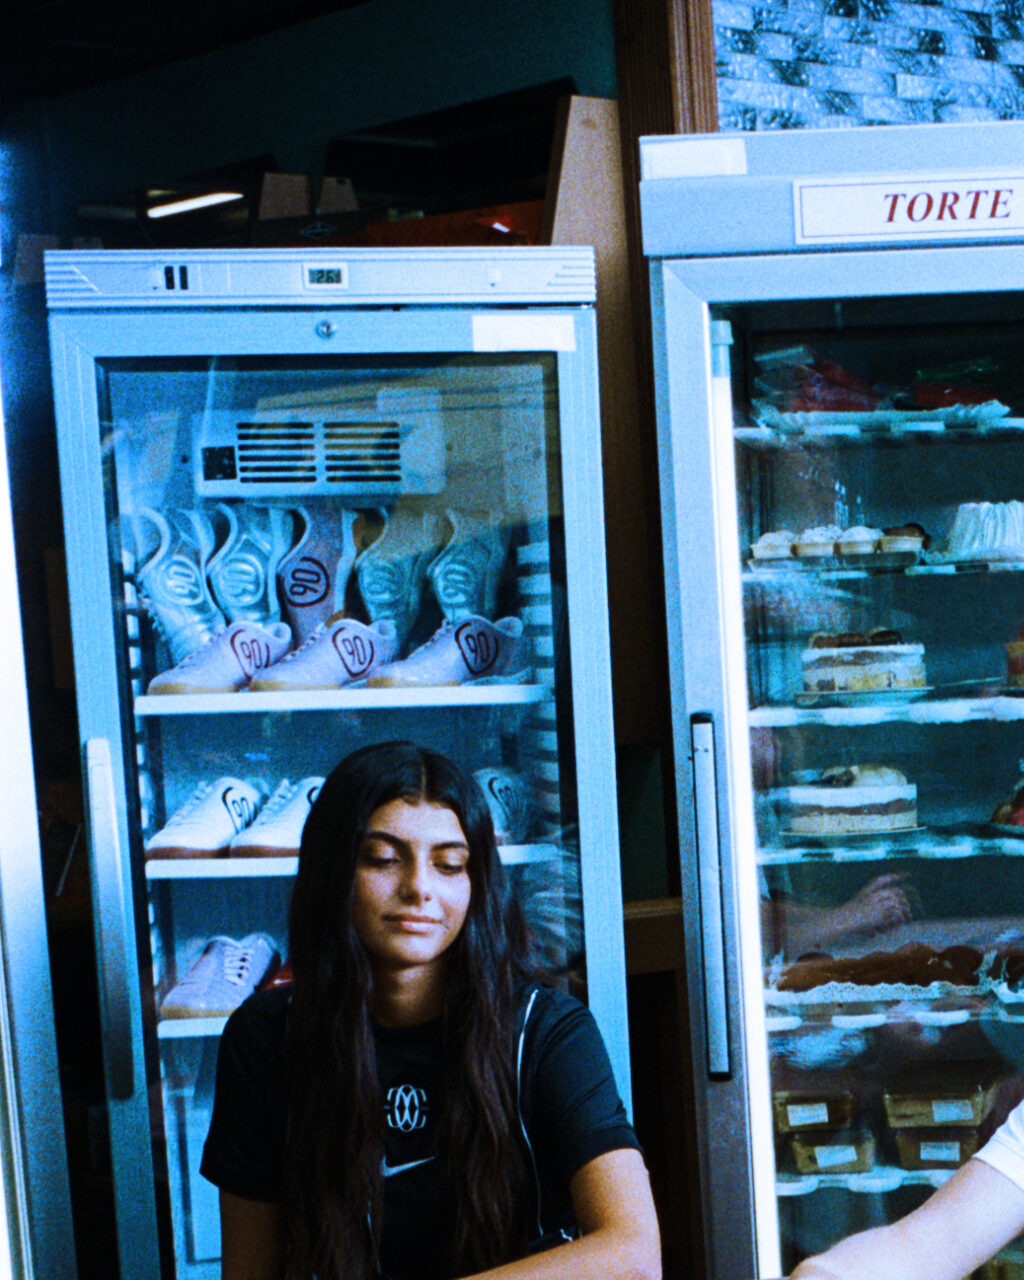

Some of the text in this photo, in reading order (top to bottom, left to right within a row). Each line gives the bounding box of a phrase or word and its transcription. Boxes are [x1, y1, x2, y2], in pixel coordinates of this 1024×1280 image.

[884, 188, 1013, 223] TORTE
[289, 567, 321, 597] 90
[240, 638, 264, 670] 90
[342, 635, 367, 666] 90
[464, 631, 491, 665] 90
